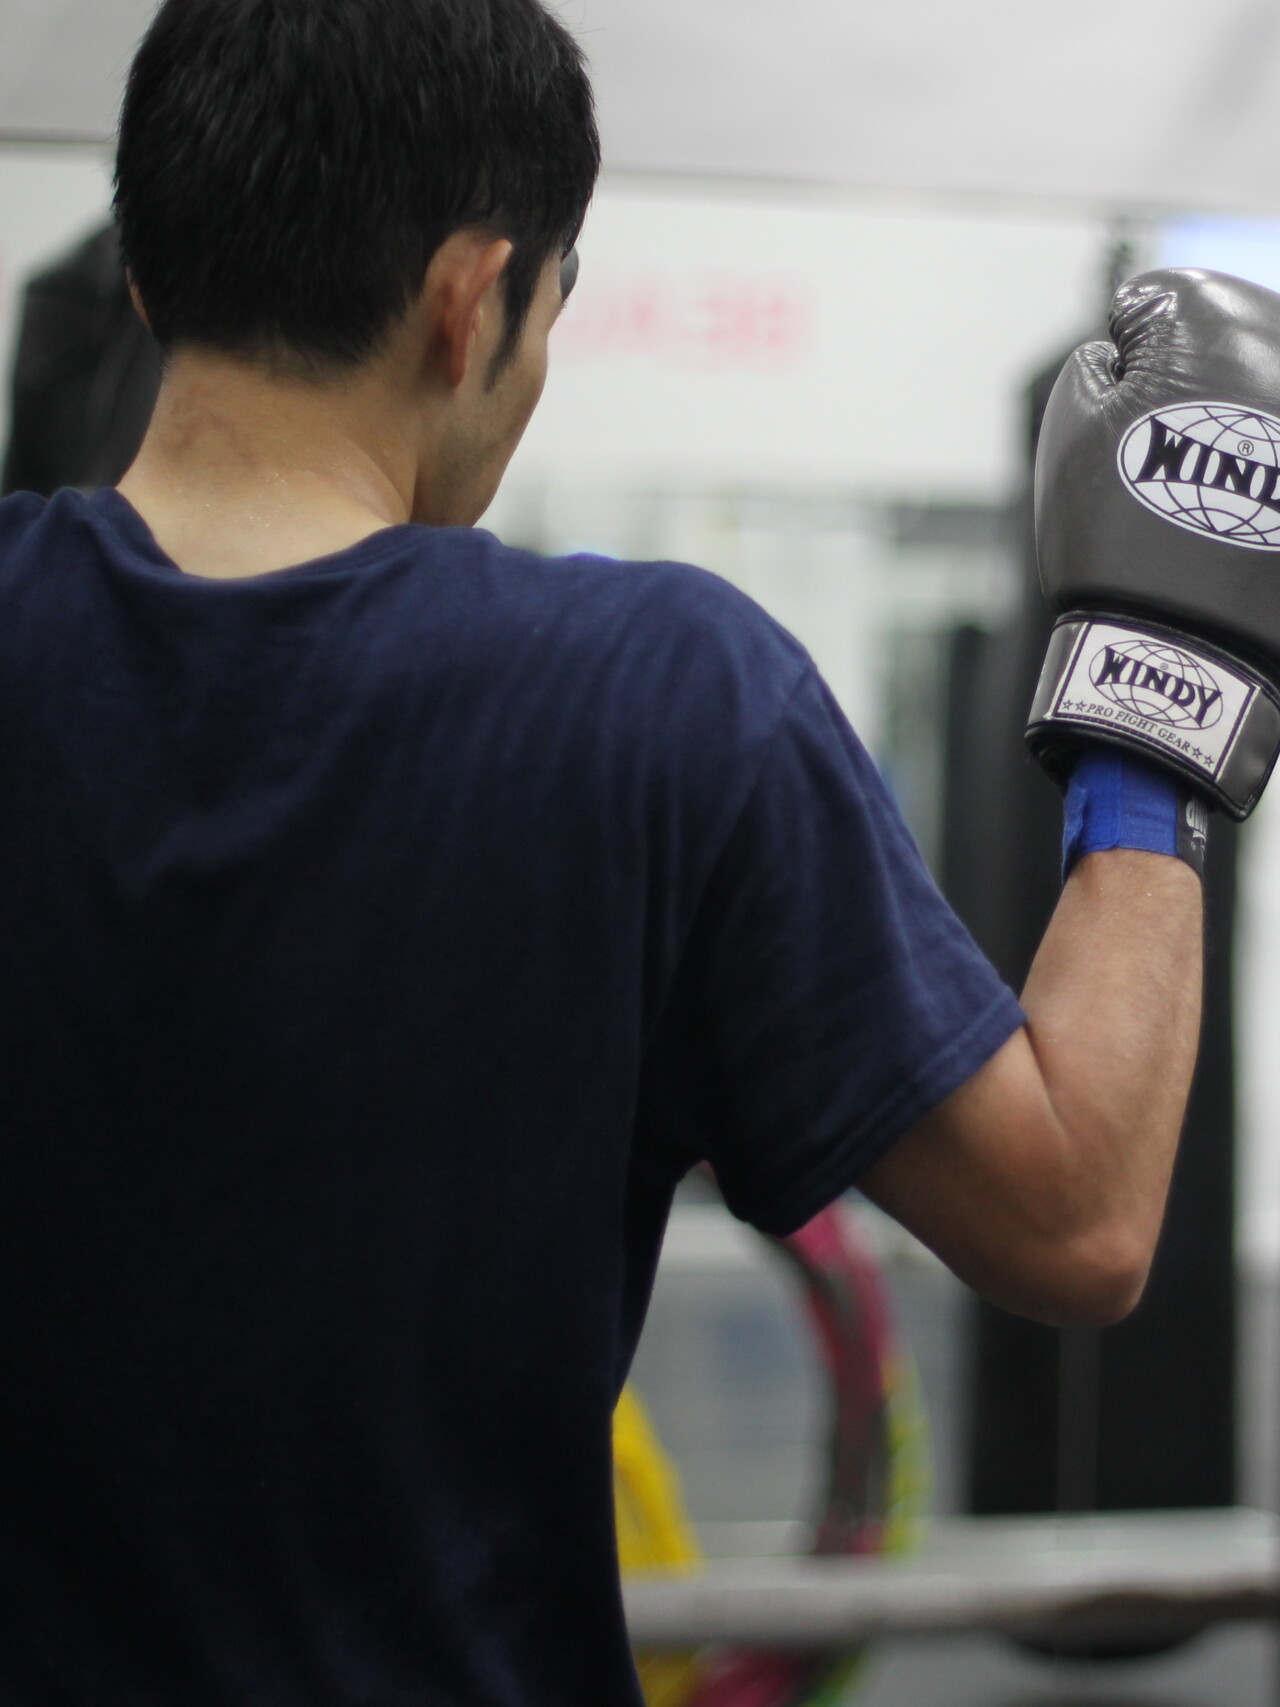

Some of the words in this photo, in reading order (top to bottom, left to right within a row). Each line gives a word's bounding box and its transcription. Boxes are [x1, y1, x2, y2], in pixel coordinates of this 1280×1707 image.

[1095, 646, 1223, 727] WINDY
[1087, 703, 1114, 718] PRO
[1117, 711, 1157, 732] FIGHT
[1157, 728, 1191, 752] GEAR
